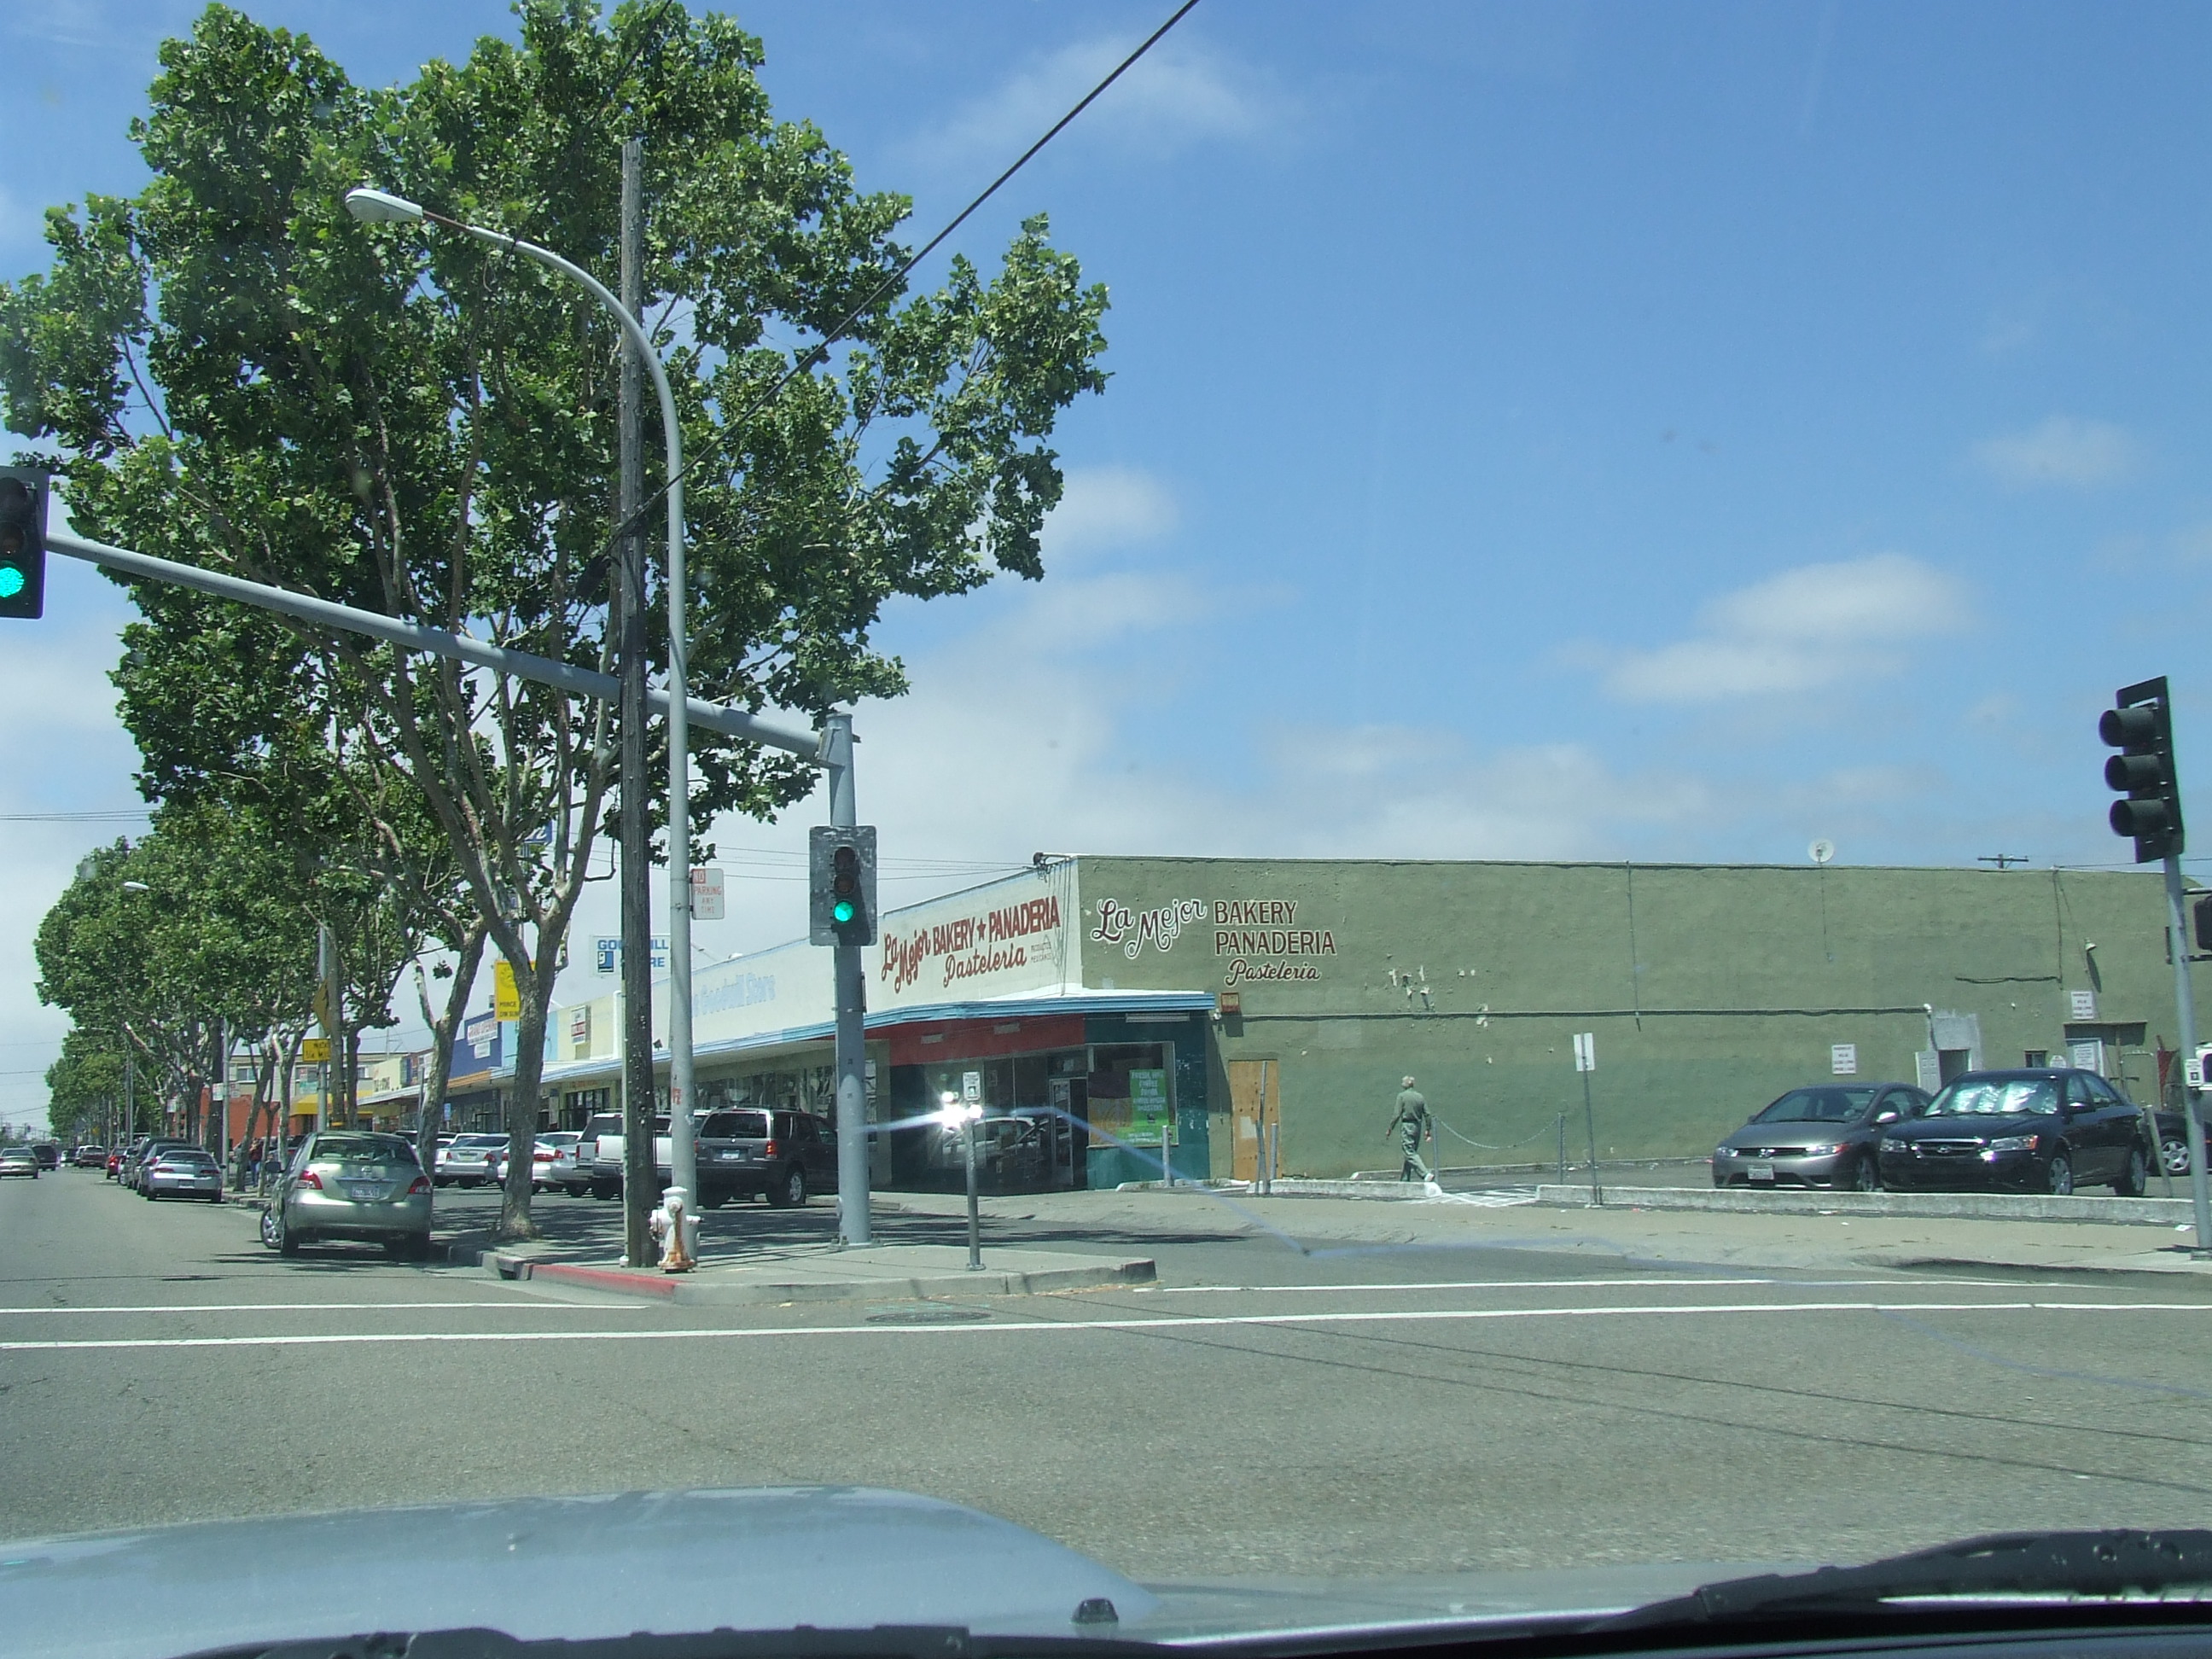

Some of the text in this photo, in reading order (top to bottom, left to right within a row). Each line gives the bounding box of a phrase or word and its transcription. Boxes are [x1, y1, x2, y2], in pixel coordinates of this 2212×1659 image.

[693, 870, 705, 882] NO
[694, 886, 722, 895] PARKING
[1214, 900, 1298, 925] BAKERY
[1091, 898, 1208, 959] La Mejor
[1214, 930, 1337, 956] PANADERIA
[882, 895, 1061, 993] La Mejor BAKERY PANADERIA
[943, 942, 1027, 988] Pasteleria
[1224, 958, 1322, 987] Pasteleria
[701, 974, 745, 1016] Goodwill
[745, 971, 776, 1005] Store
